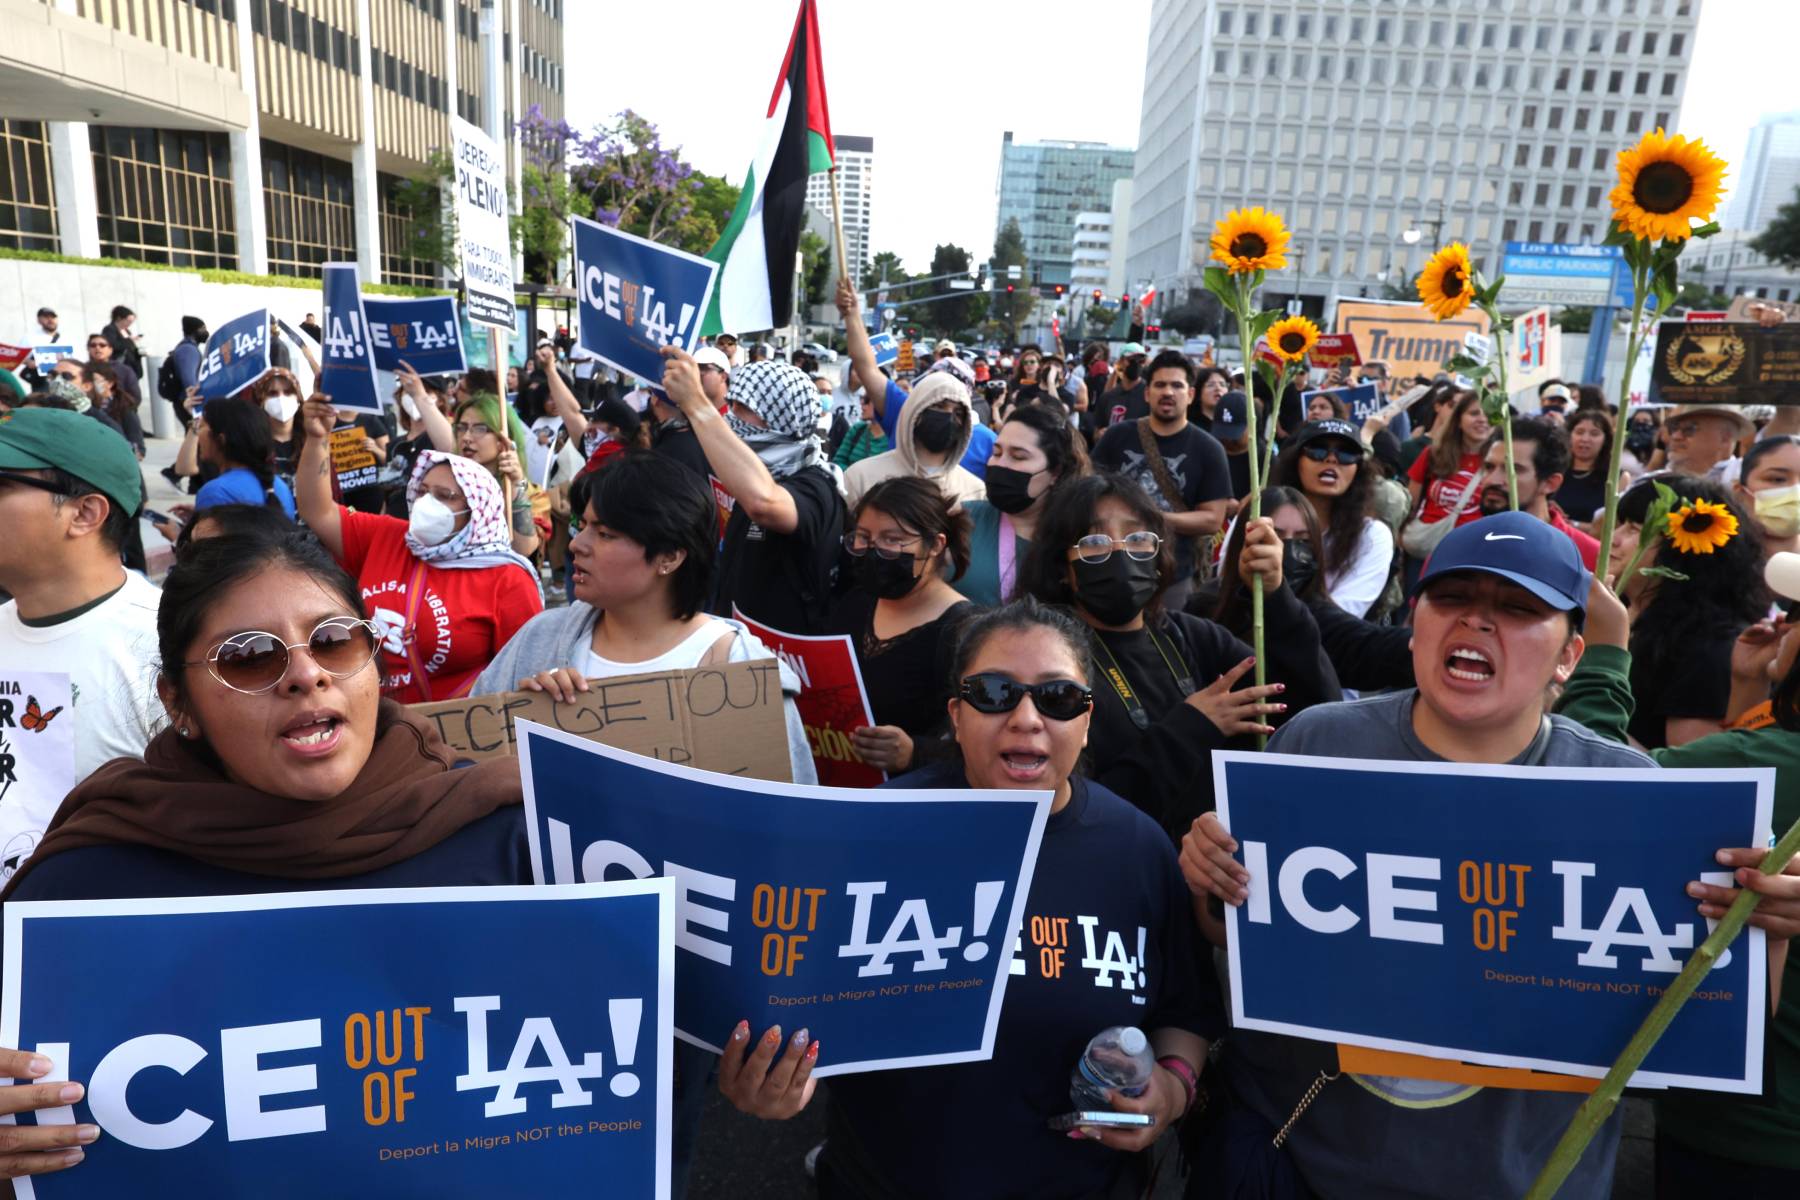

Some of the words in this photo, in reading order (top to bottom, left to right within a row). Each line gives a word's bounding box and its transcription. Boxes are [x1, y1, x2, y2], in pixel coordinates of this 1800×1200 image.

[1509, 257, 1552, 270] PUBLIC
[1556, 259, 1611, 272] PARKING
[1520, 243, 1546, 254] LOS
[1551, 244, 1612, 256] ANGELES
[579, 260, 621, 320] ICE
[640, 285, 695, 347] LA!
[199, 351, 222, 382] CE
[234, 325, 264, 358] LA!
[324, 305, 364, 359] LA!
[411, 320, 455, 349] LA!
[1369, 329, 1461, 370] Trump
[1354, 400, 1377, 420] LA!
[362, 580, 407, 599] ALISM
[424, 588, 451, 673] LIBERATION
[553, 676, 685, 734] GET
[687, 665, 778, 717] OUT
[751, 883, 826, 931] OUT
[1243, 840, 1444, 945] ICE
[1458, 860, 1531, 908] OUT
[838, 881, 1005, 977] LA!
[1031, 915, 1070, 948] OUT
[1077, 915, 1147, 990] LA!
[1473, 908, 1518, 952] OF
[760, 933, 808, 976] OF
[1040, 949, 1066, 979] OF
[768, 995, 817, 1007] Deport
[823, 993, 834, 1002] la
[838, 990, 875, 1001] Migra
[880, 985, 910, 996] NOT
[914, 983, 935, 993] the
[939, 977, 984, 990] People
[1484, 969, 1536, 985] Deport
[1541, 975, 1554, 987] la
[1560, 977, 1601, 993] Migra
[1606, 983, 1641, 996] NOT
[1690, 990, 1734, 1001] eople
[344, 1006, 431, 1069] OUT
[454, 995, 643, 1118] LA!
[36, 1018, 327, 1151] ICE
[363, 1069, 414, 1126] OF
[379, 1142, 440, 1161] Deport
[446, 1140, 459, 1152] la
[465, 1135, 511, 1150] Migra
[516, 1127, 552, 1142] NOT
[558, 1123, 583, 1137] the
[589, 1118, 642, 1134] People
